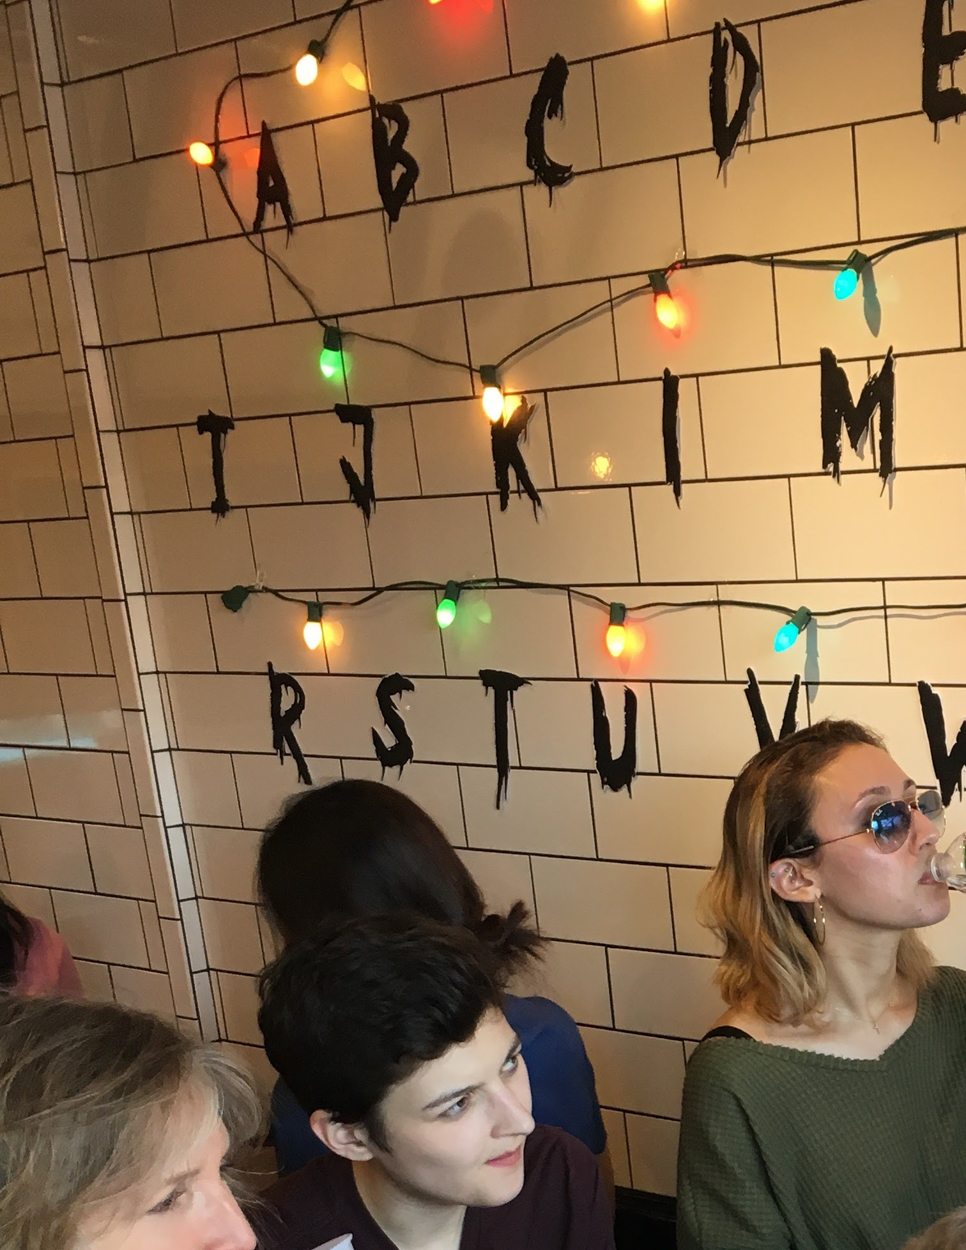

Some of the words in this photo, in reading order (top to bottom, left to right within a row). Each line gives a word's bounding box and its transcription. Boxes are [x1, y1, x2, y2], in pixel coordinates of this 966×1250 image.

[253, 121, 294, 245] A
[370, 95, 421, 230] B
[526, 54, 573, 200] C
[710, 18, 761, 176] D
[334, 403, 376, 525] J
[489, 394, 542, 515] K
[820, 347, 896, 485] M
[267, 660, 314, 784] R
[371, 673, 415, 778] S
[479, 669, 531, 808] T
[591, 681, 639, 797] U
